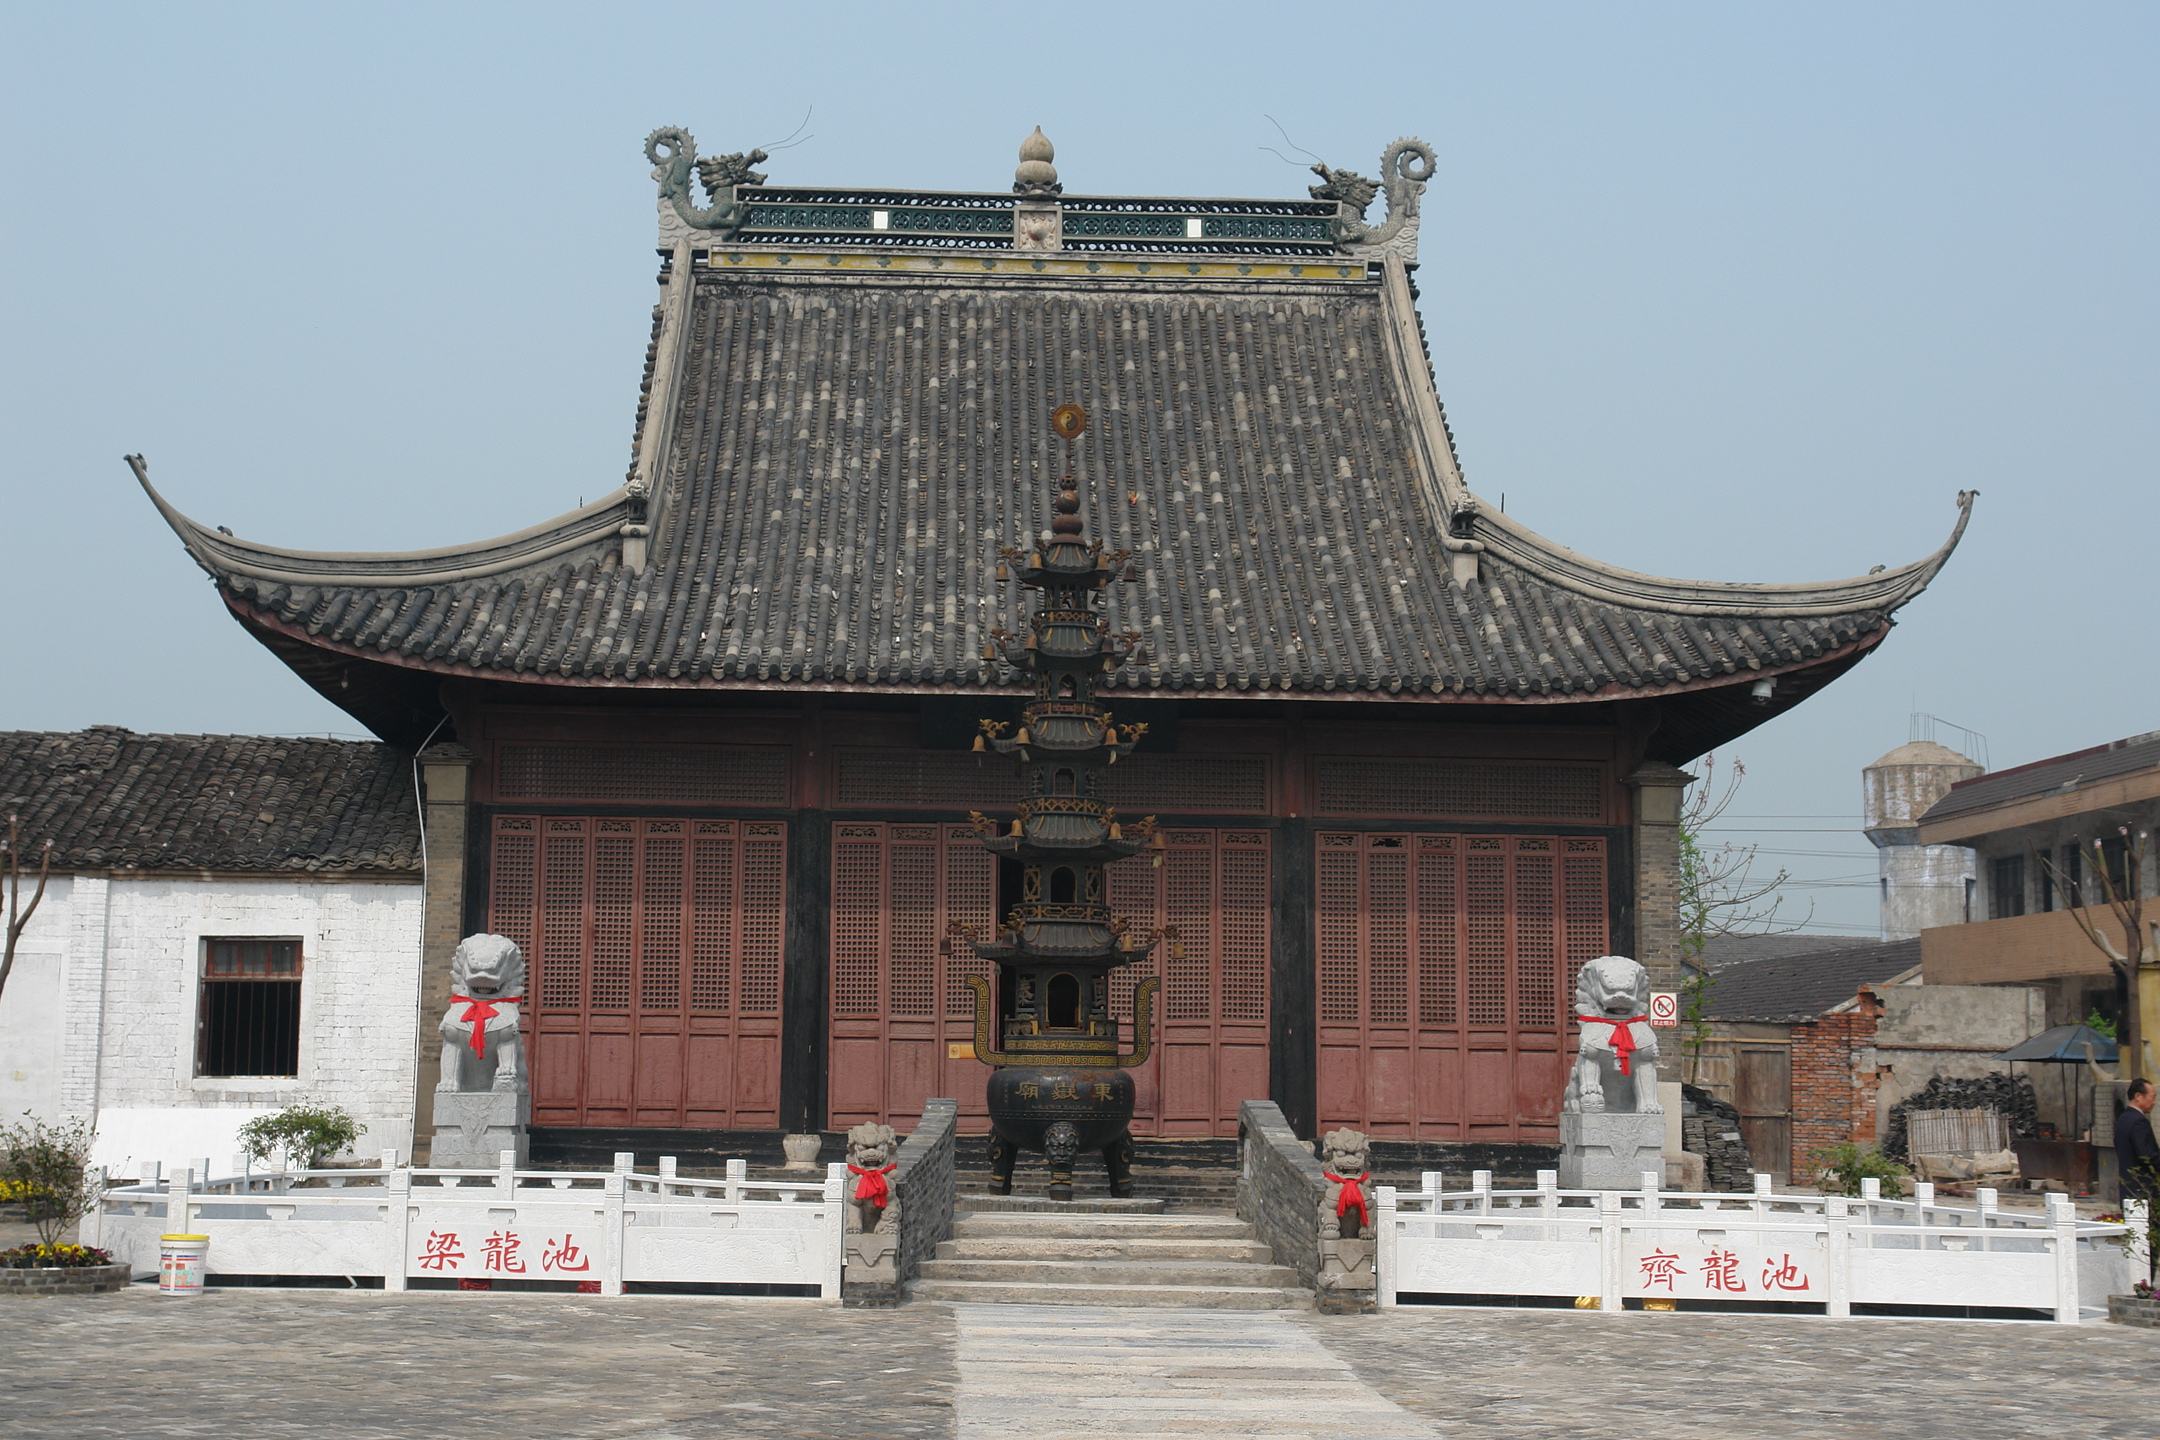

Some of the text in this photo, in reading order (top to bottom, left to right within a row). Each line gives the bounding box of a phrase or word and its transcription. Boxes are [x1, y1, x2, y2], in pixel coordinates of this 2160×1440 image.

[418, 1230, 590, 1274] 梁龍池
[1640, 1247, 1810, 1293] 齊龍池
